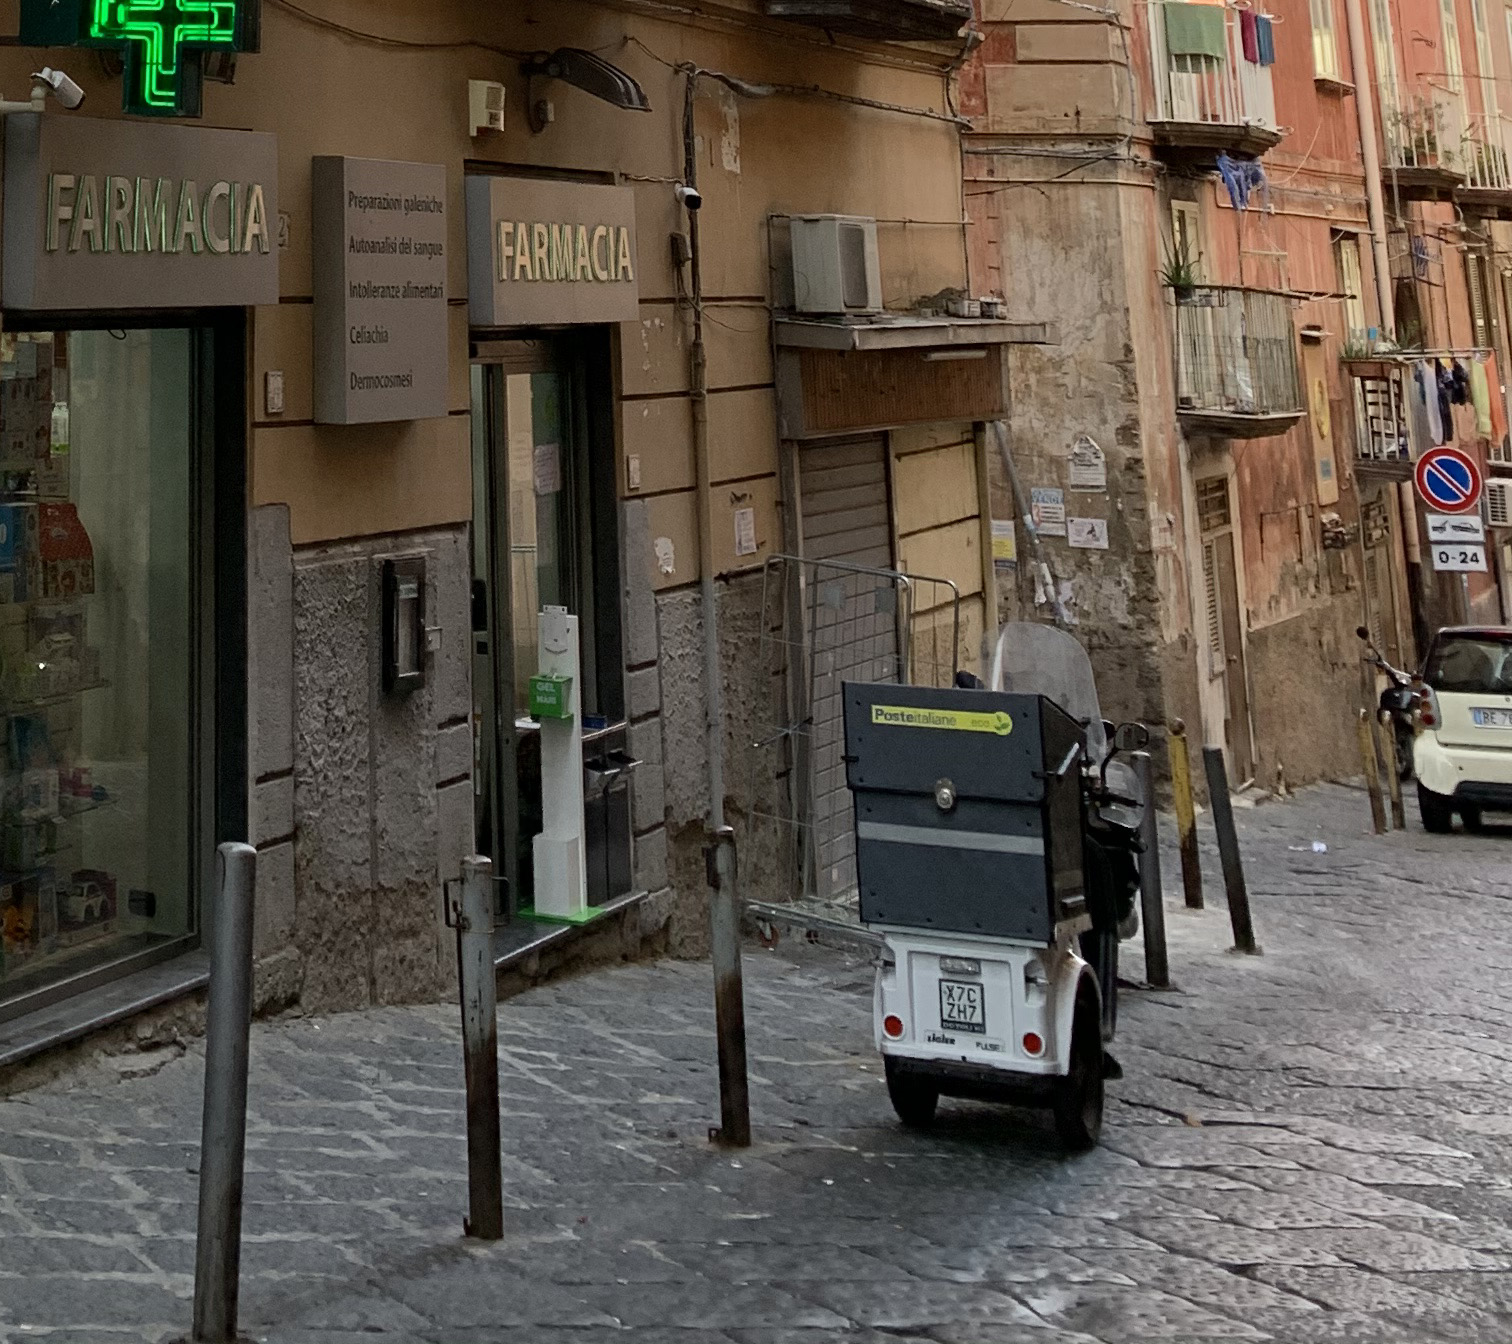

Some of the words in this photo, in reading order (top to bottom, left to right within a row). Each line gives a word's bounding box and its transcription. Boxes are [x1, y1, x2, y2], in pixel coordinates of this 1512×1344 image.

[45, 172, 270, 254] FARMACIA
[348, 190, 402, 213] Preparazioni
[404, 194, 443, 216] galeniche
[349, 235, 397, 254] Autoanalisi
[399, 237, 412, 254] del
[413, 241, 443, 260] sangue
[497, 220, 634, 282] FARMACIA
[349, 280, 400, 298] Intolleranze
[402, 280, 443, 298] alimentari
[350, 325, 389, 344] Celiachia
[350, 369, 413, 390] Dermocosmesi
[874, 707, 957, 727] Posteitaliane
[946, 984, 976, 1003] X7C
[947, 1002, 977, 1021] ZH7
